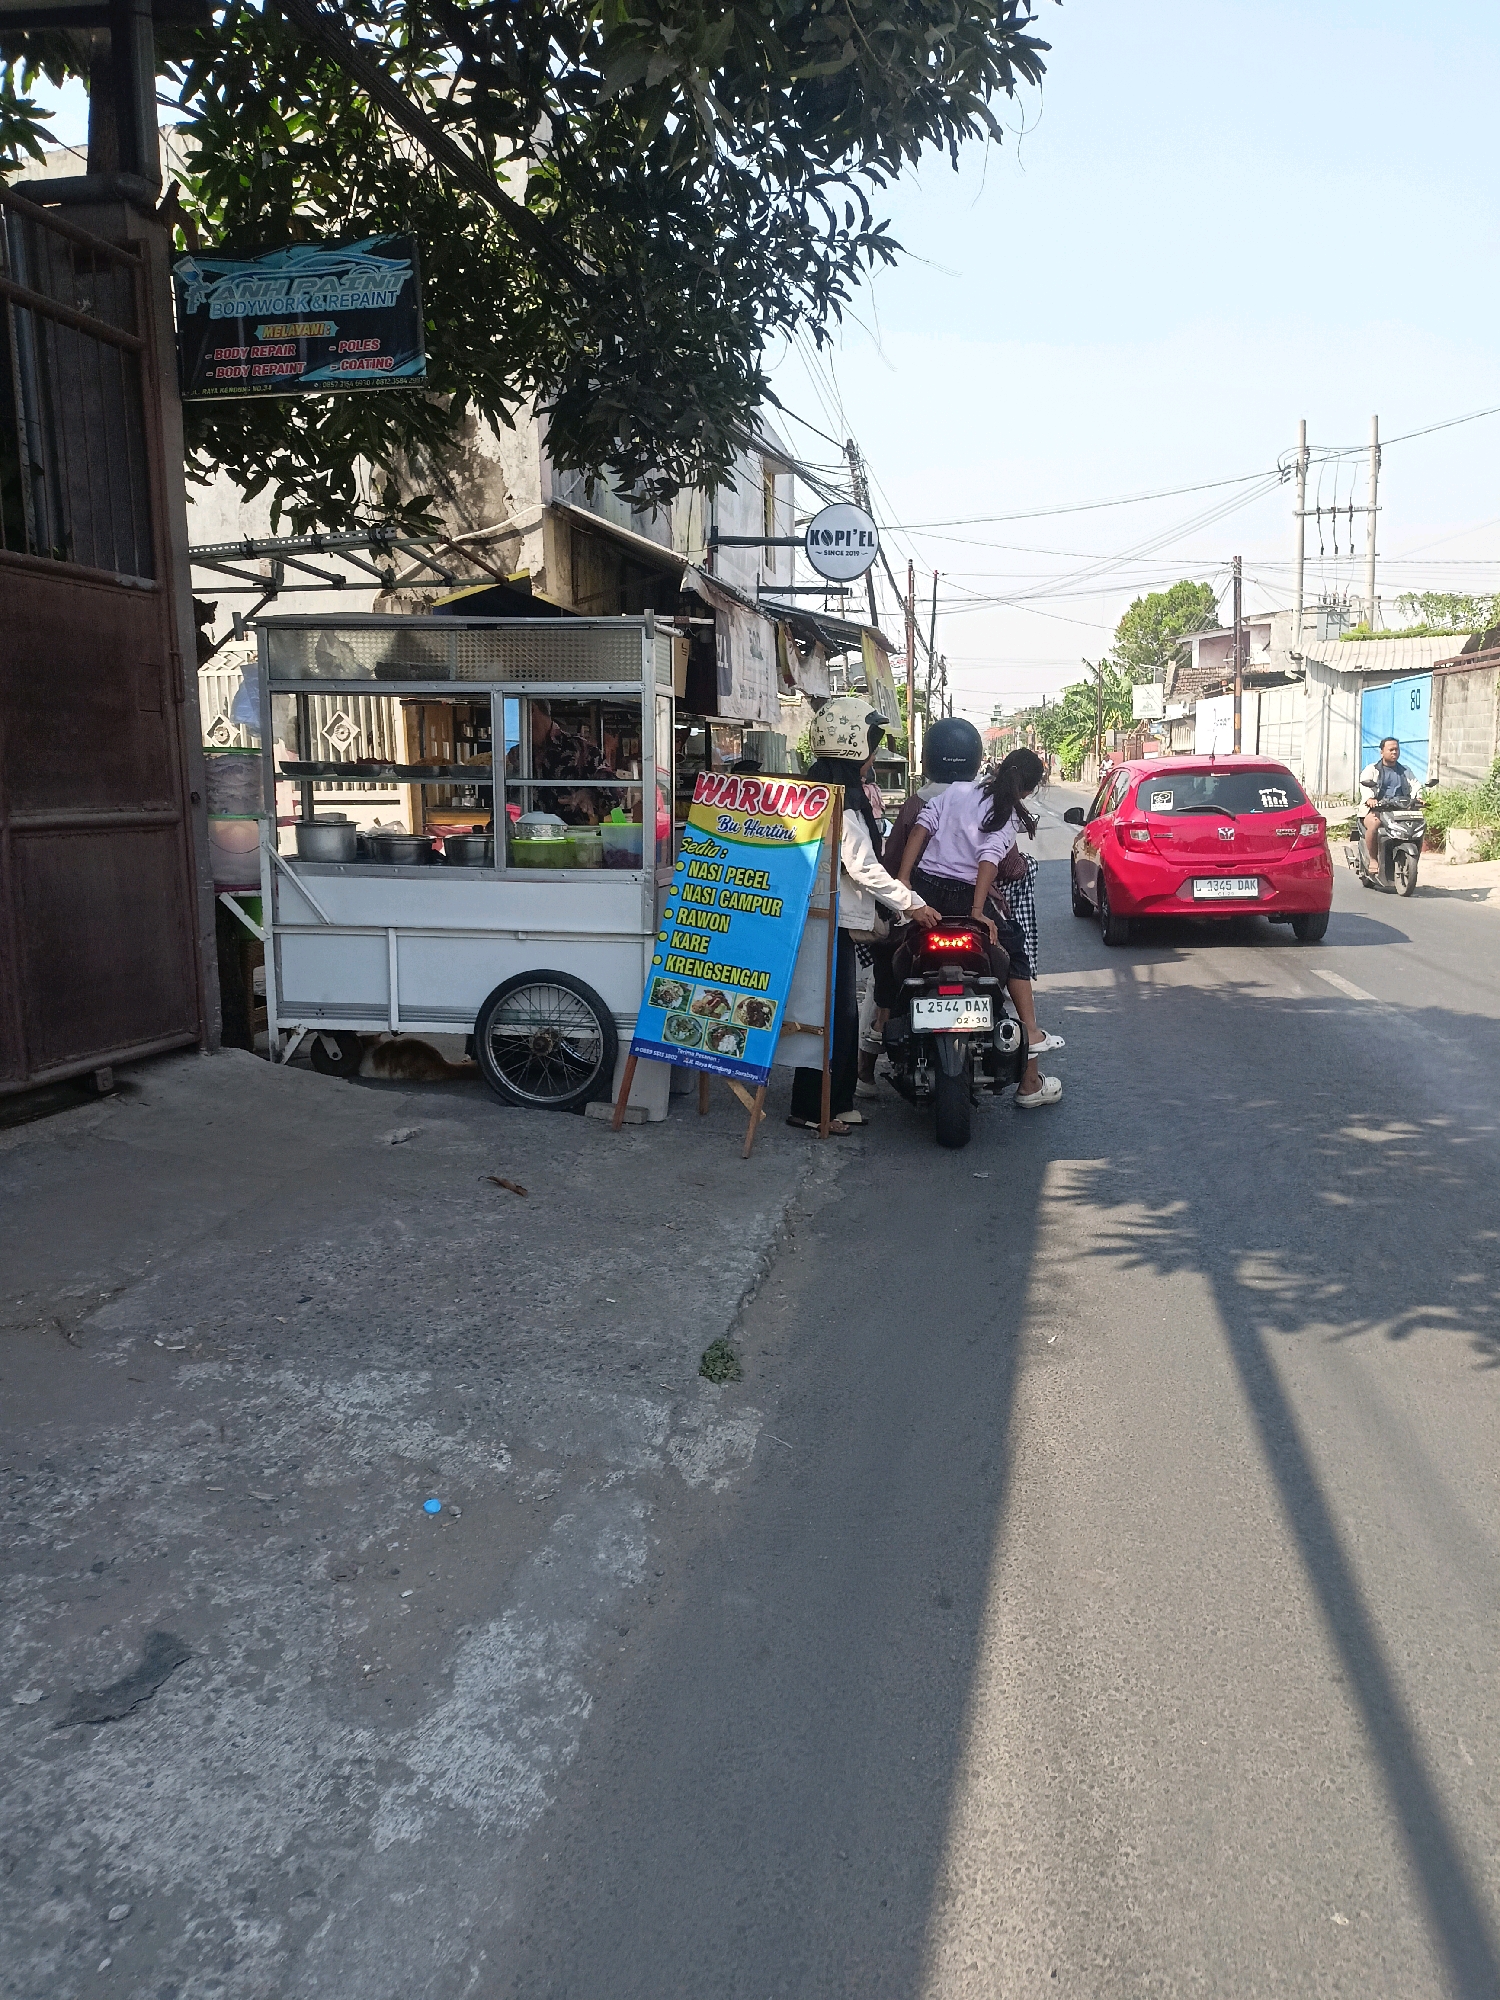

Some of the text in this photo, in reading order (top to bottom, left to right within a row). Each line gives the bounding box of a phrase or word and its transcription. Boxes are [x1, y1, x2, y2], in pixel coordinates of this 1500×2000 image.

[291, 270, 413, 295] PAINT
[210, 289, 398, 318] BODYWORK & REPAINT
[214, 347, 249, 361] BODY
[250, 343, 296, 358] REPAIR
[338, 339, 381, 353] POLES
[215, 366, 250, 378] BODY
[251, 361, 306, 377] REPAINT
[340, 356, 394, 371] COATING
[202, 387, 218, 395] RAYA
[823, 549, 844, 557] SINCE
[839, 749, 862, 758] JPN
[692, 771, 831, 821] WARUNG
[716, 814, 798, 842] Bu Hartini
[680, 837, 721, 858] Sedia
[687, 859, 771, 891] NASI PECEL
[1206, 880, 1232, 891] 1345
[1237, 879, 1257, 891] DAK
[681, 882, 784, 918] NASI CAMPUR
[675, 906, 731, 933] RAWON
[669, 930, 711, 954] KARE
[663, 953, 771, 991] KRENGSENGAN
[915, 1000, 989, 1014] L 2544 DAX
[677, 1047, 695, 1057] Terima
[695, 1051, 717, 1062] Pesanan
[734, 1068, 759, 1081] Surabaya
